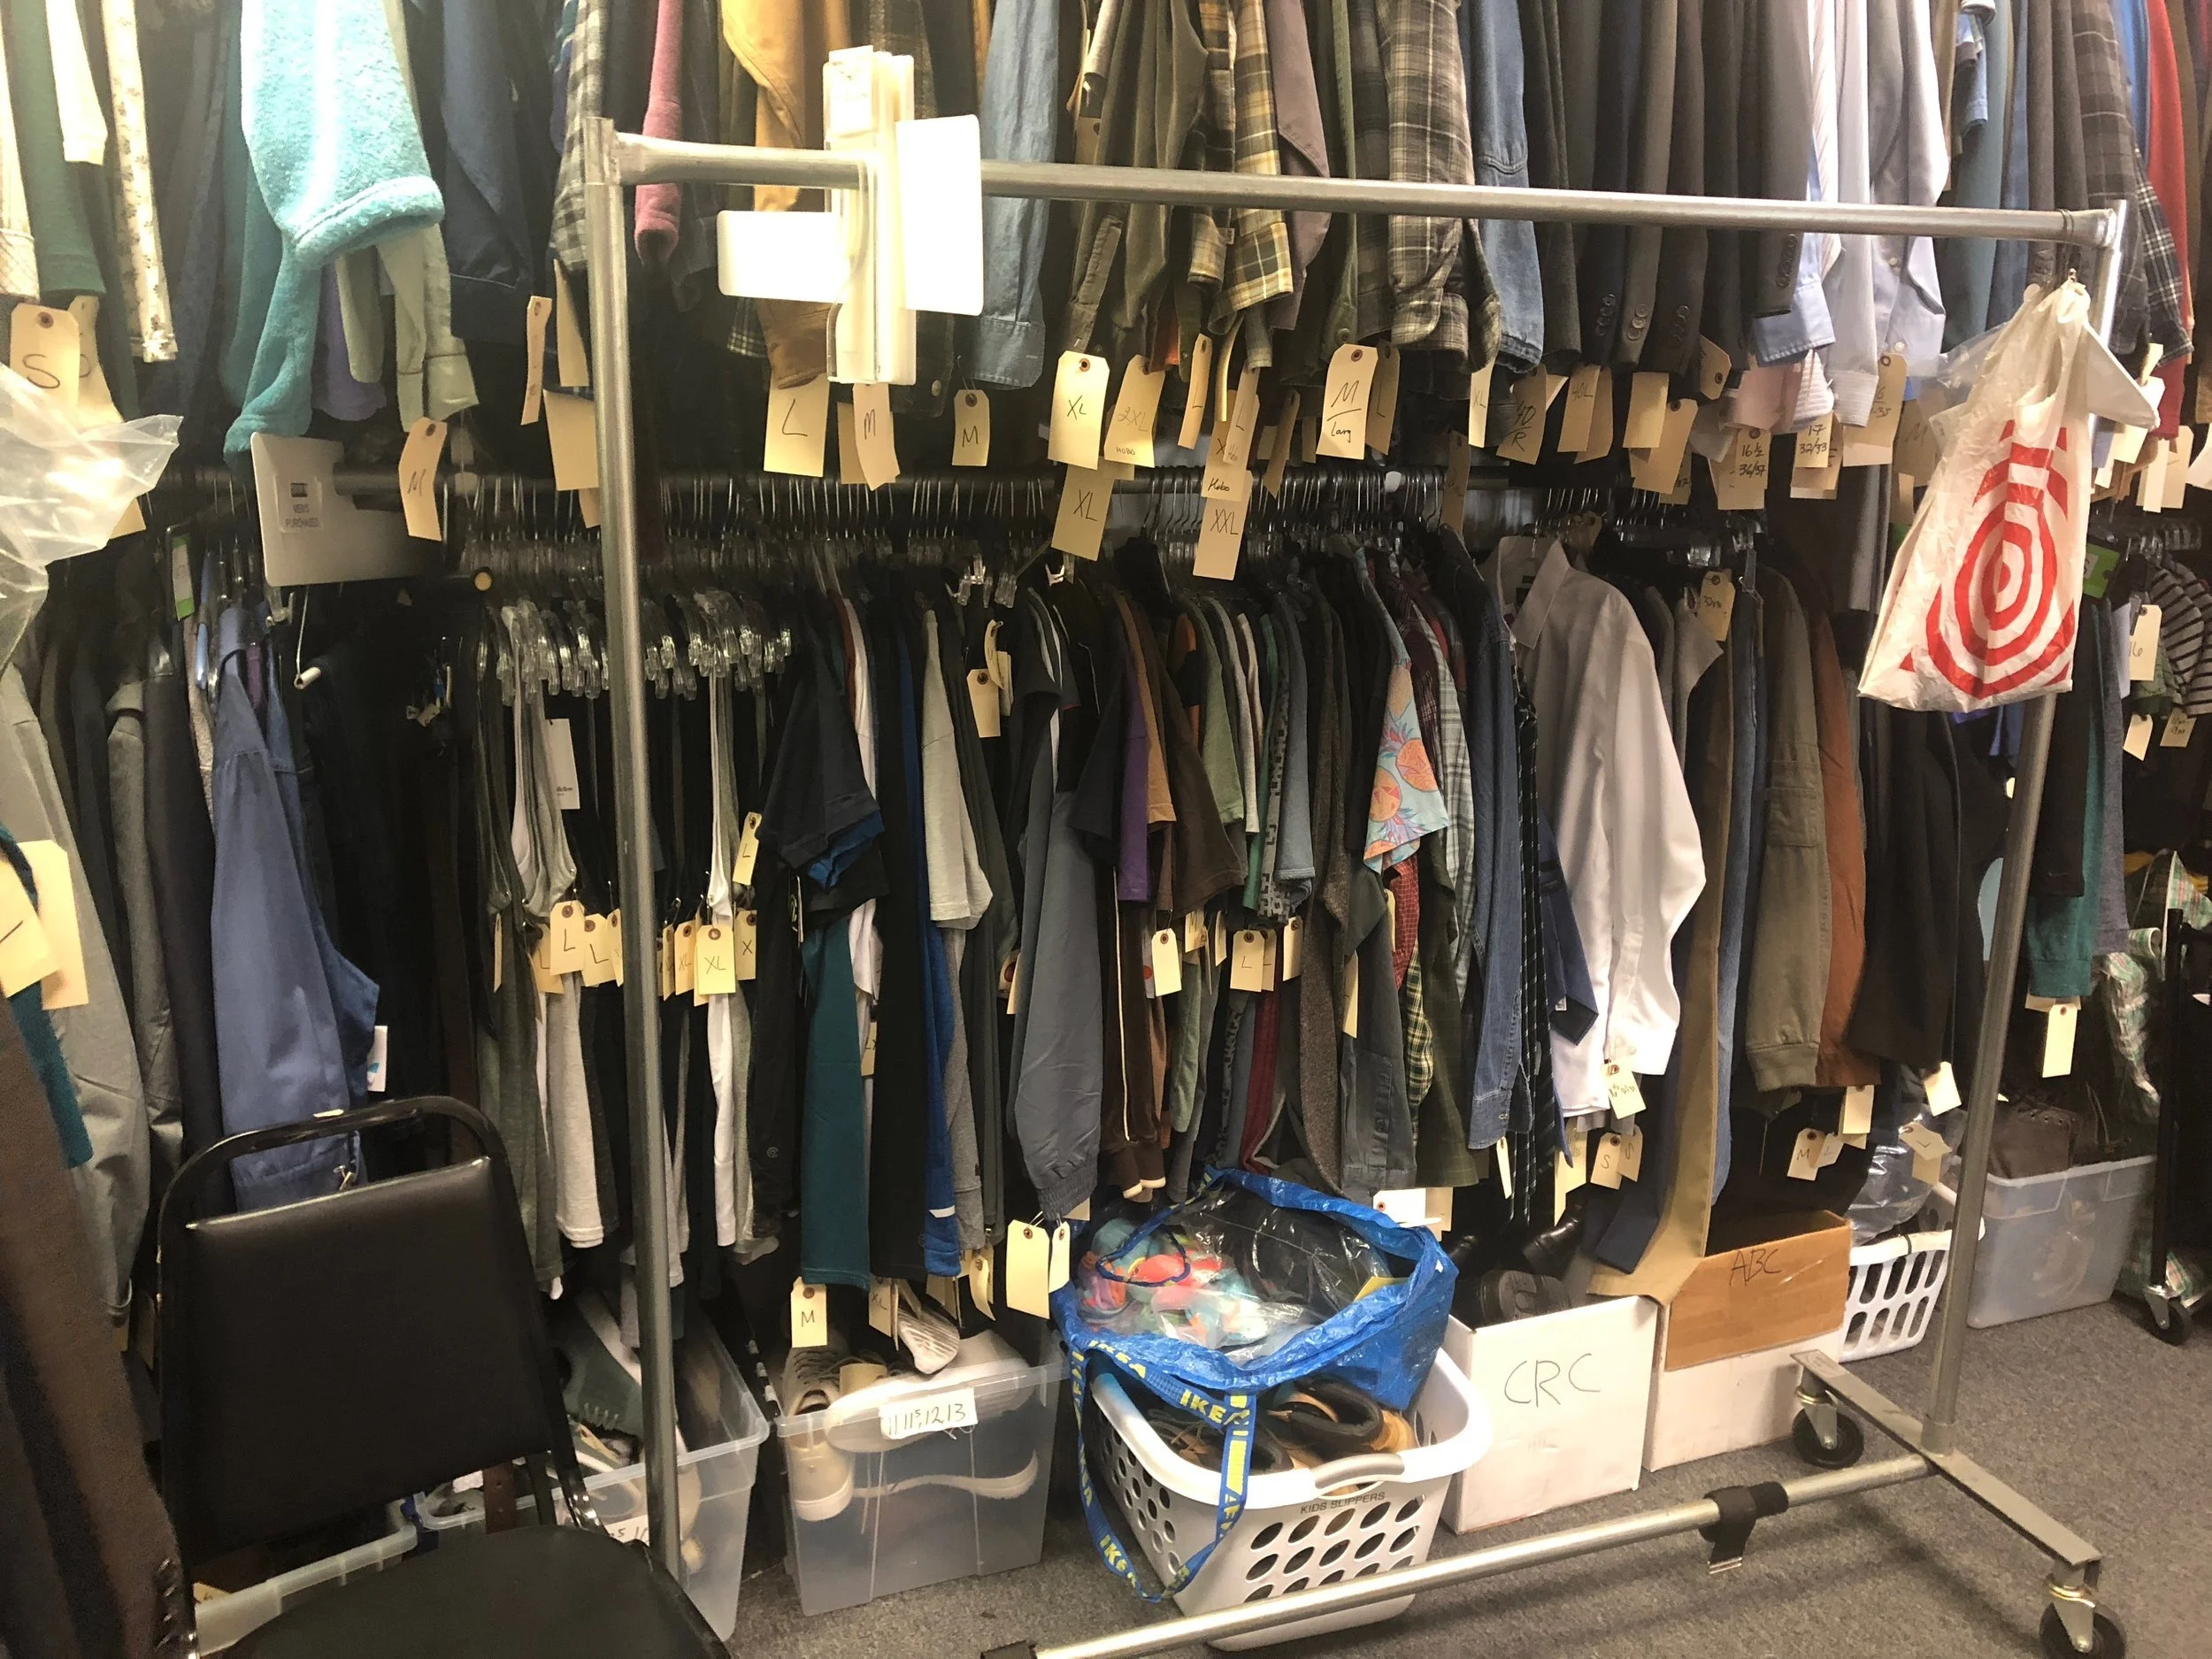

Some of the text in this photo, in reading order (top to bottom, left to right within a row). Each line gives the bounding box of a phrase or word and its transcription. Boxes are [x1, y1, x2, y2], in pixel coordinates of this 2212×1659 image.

[22, 353, 61, 389] S
[1331, 380, 1360, 408] M
[1471, 388, 1486, 409] XL
[781, 398, 809, 437] L
[1066, 395, 1087, 420] XL
[1117, 406, 1148, 433] 2XL
[1235, 399, 1245, 432] L
[864, 409, 876, 440] M
[962, 425, 979, 448] M
[1511, 431, 1527, 452] R
[1073, 488, 1098, 522] XL
[1210, 508, 1239, 535] XXL
[742, 843, 751, 858] L
[564, 928, 576, 952] L
[589, 943, 609, 964] L
[679, 952, 692, 972] XL
[704, 955, 726, 974] XL
[1240, 956, 1253, 968] L
[1601, 1154, 1610, 1170] S
[1796, 1148, 1810, 1161] M
[1729, 1248, 1783, 1286] ABC
[801, 1310, 815, 1327] M
[1503, 1353, 1601, 1408] CRC
[1300, 1491, 1386, 1515] KIDS SLIPPERS
